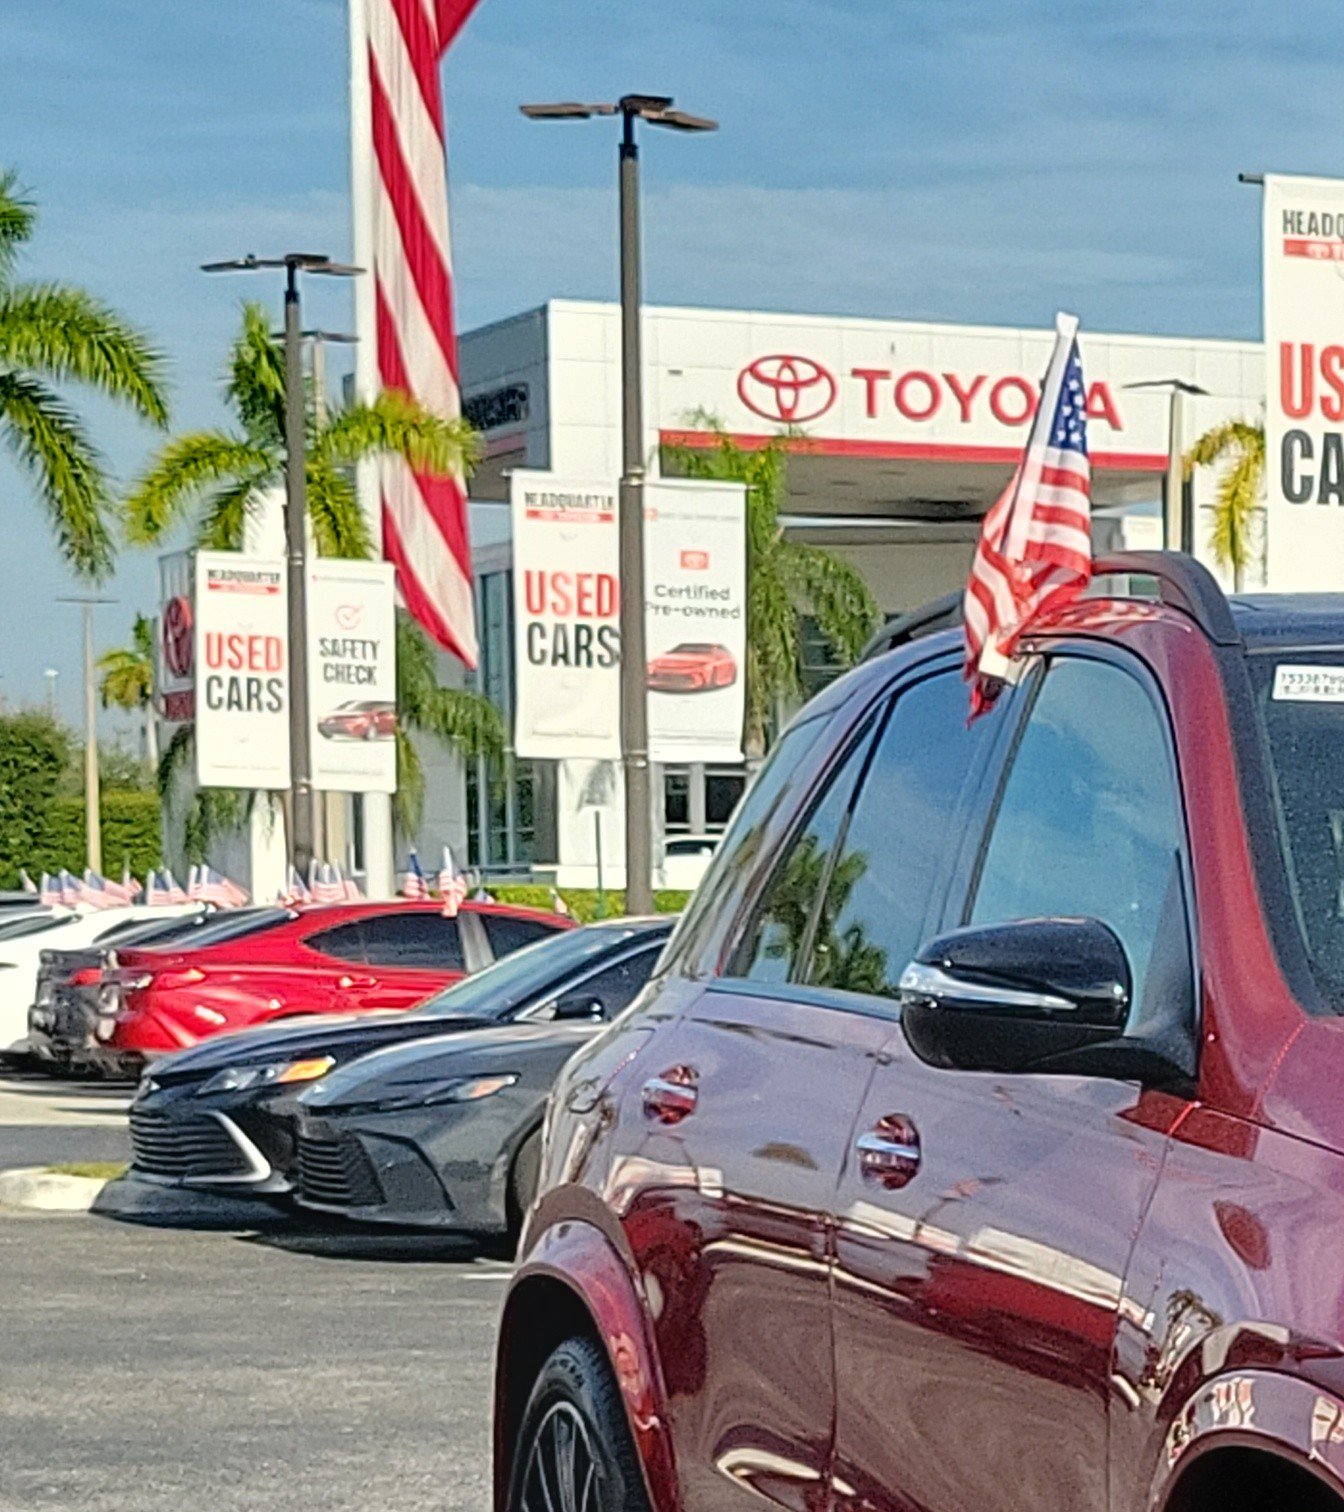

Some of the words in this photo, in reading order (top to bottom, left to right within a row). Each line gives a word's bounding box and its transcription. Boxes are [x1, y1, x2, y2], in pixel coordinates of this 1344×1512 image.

[851, 368, 1123, 431] TOYOA
[524, 570, 619, 619] USED
[654, 584, 731, 602] Certified
[206, 632, 283, 673] USED
[319, 637, 380, 661] SAFETY
[527, 621, 620, 668] CARS
[323, 662, 378, 686] CHECK
[206, 675, 285, 713] CARS
